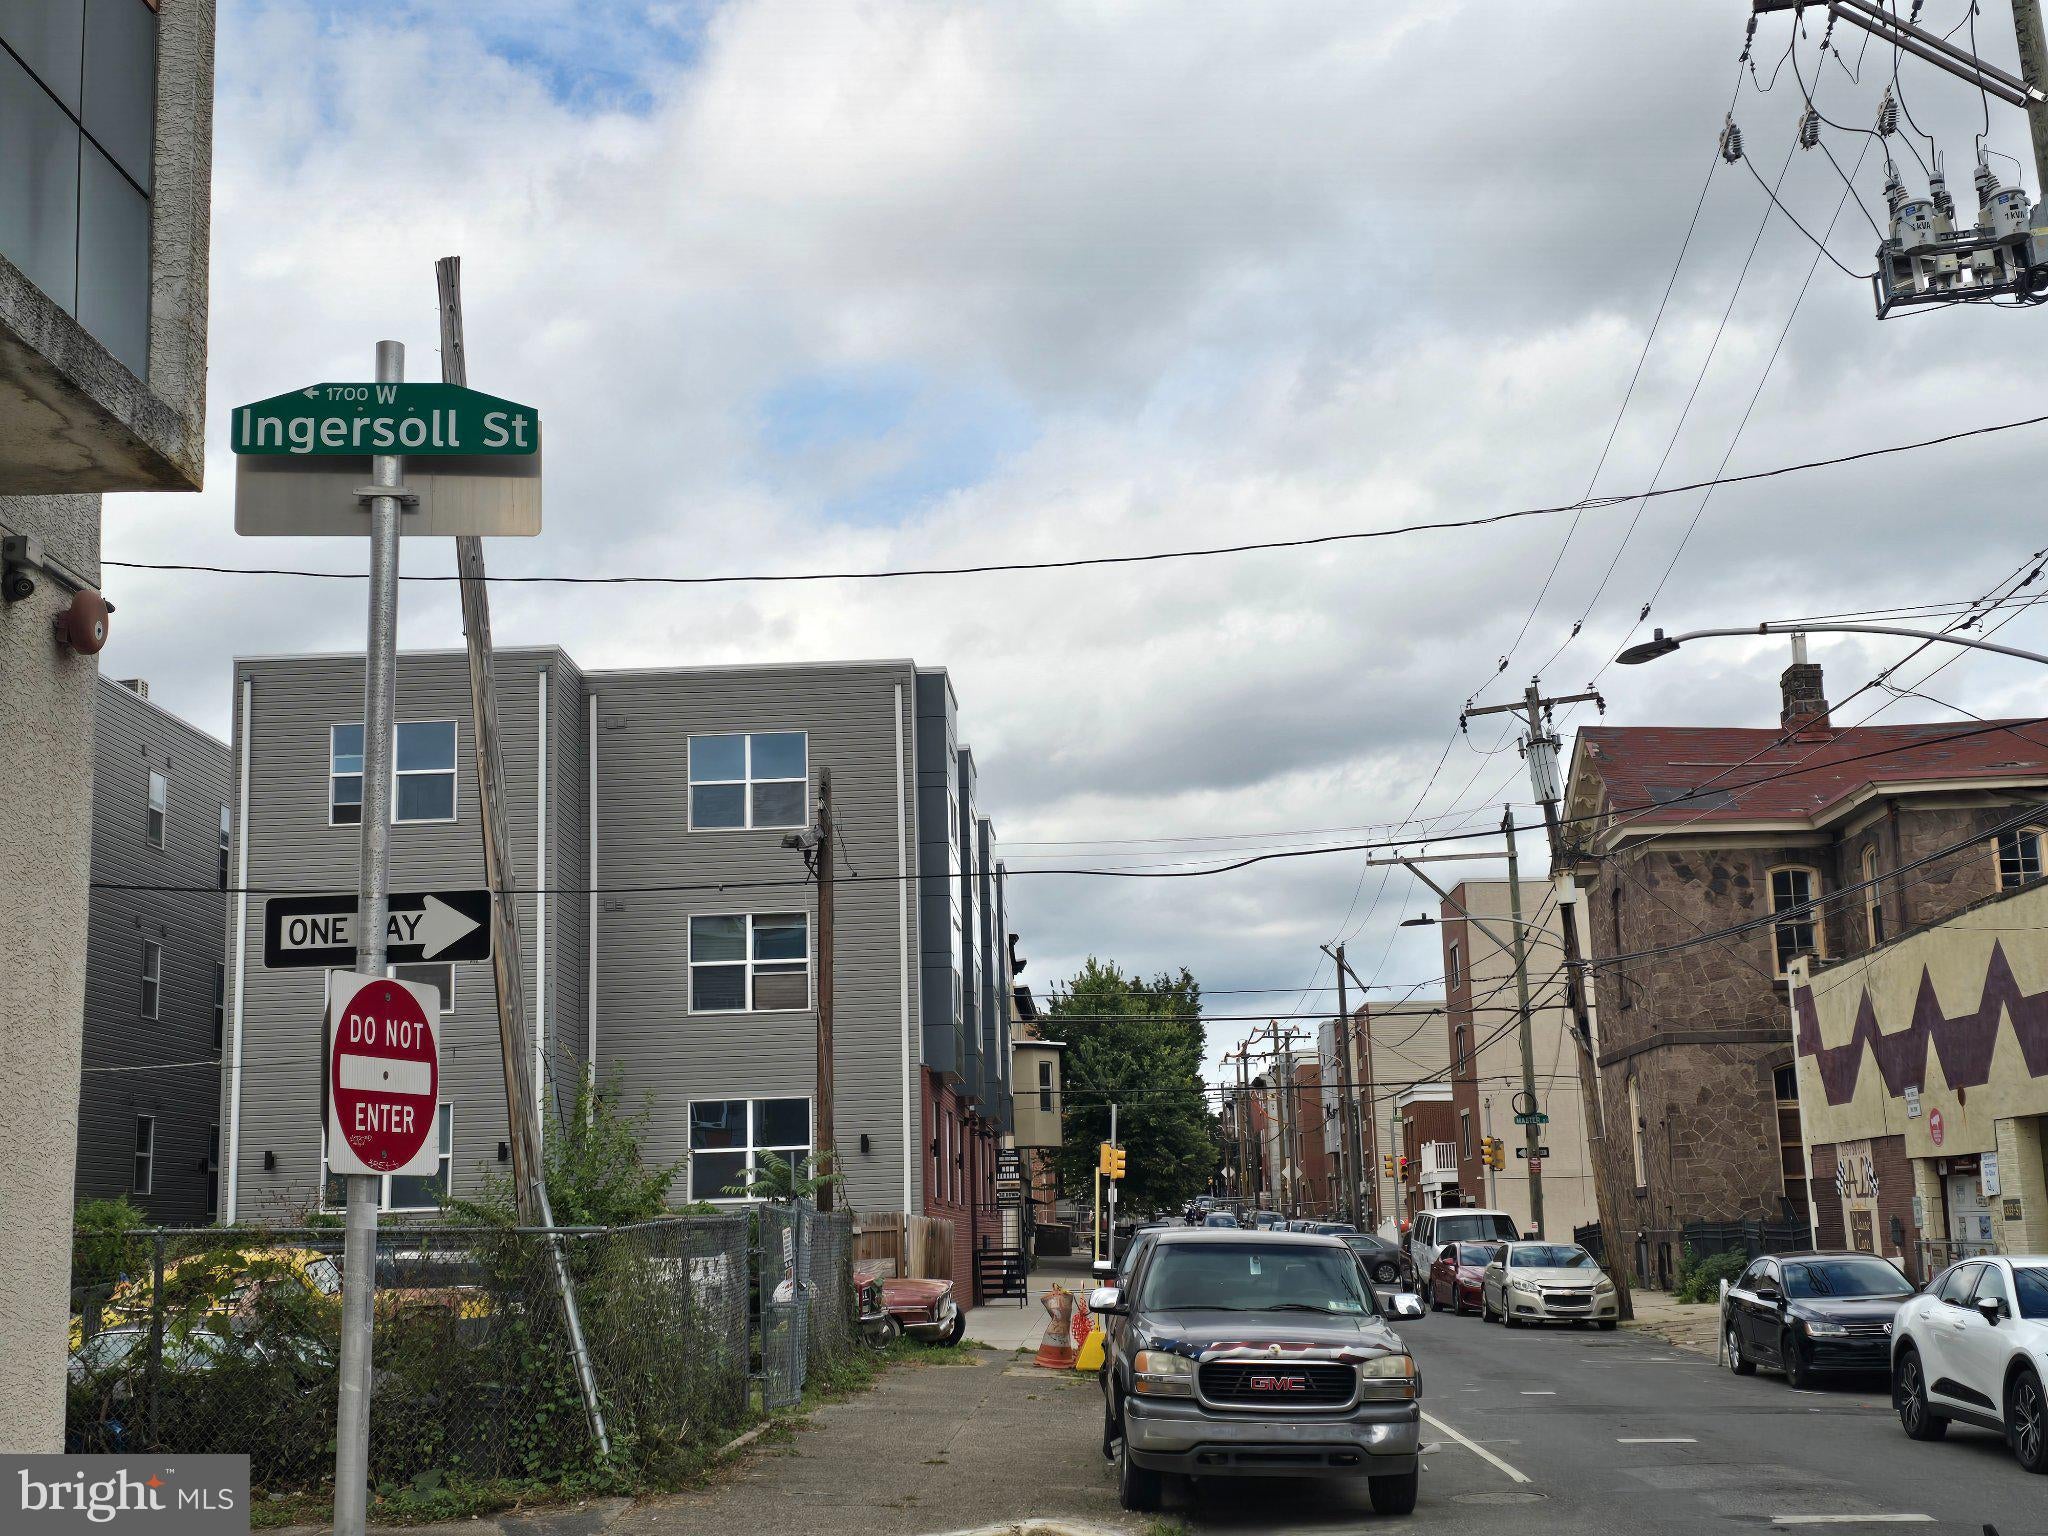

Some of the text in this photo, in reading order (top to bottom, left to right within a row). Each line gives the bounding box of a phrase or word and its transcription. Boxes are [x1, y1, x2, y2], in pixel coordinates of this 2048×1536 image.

[326, 385, 398, 404] 1700 W
[241, 409, 528, 453] Ingersoll St
[288, 914, 423, 946] ONE AY
[350, 1014, 424, 1050] DO NOT
[355, 1102, 414, 1134] ENTER
[1251, 1376, 1306, 1391] GMC
